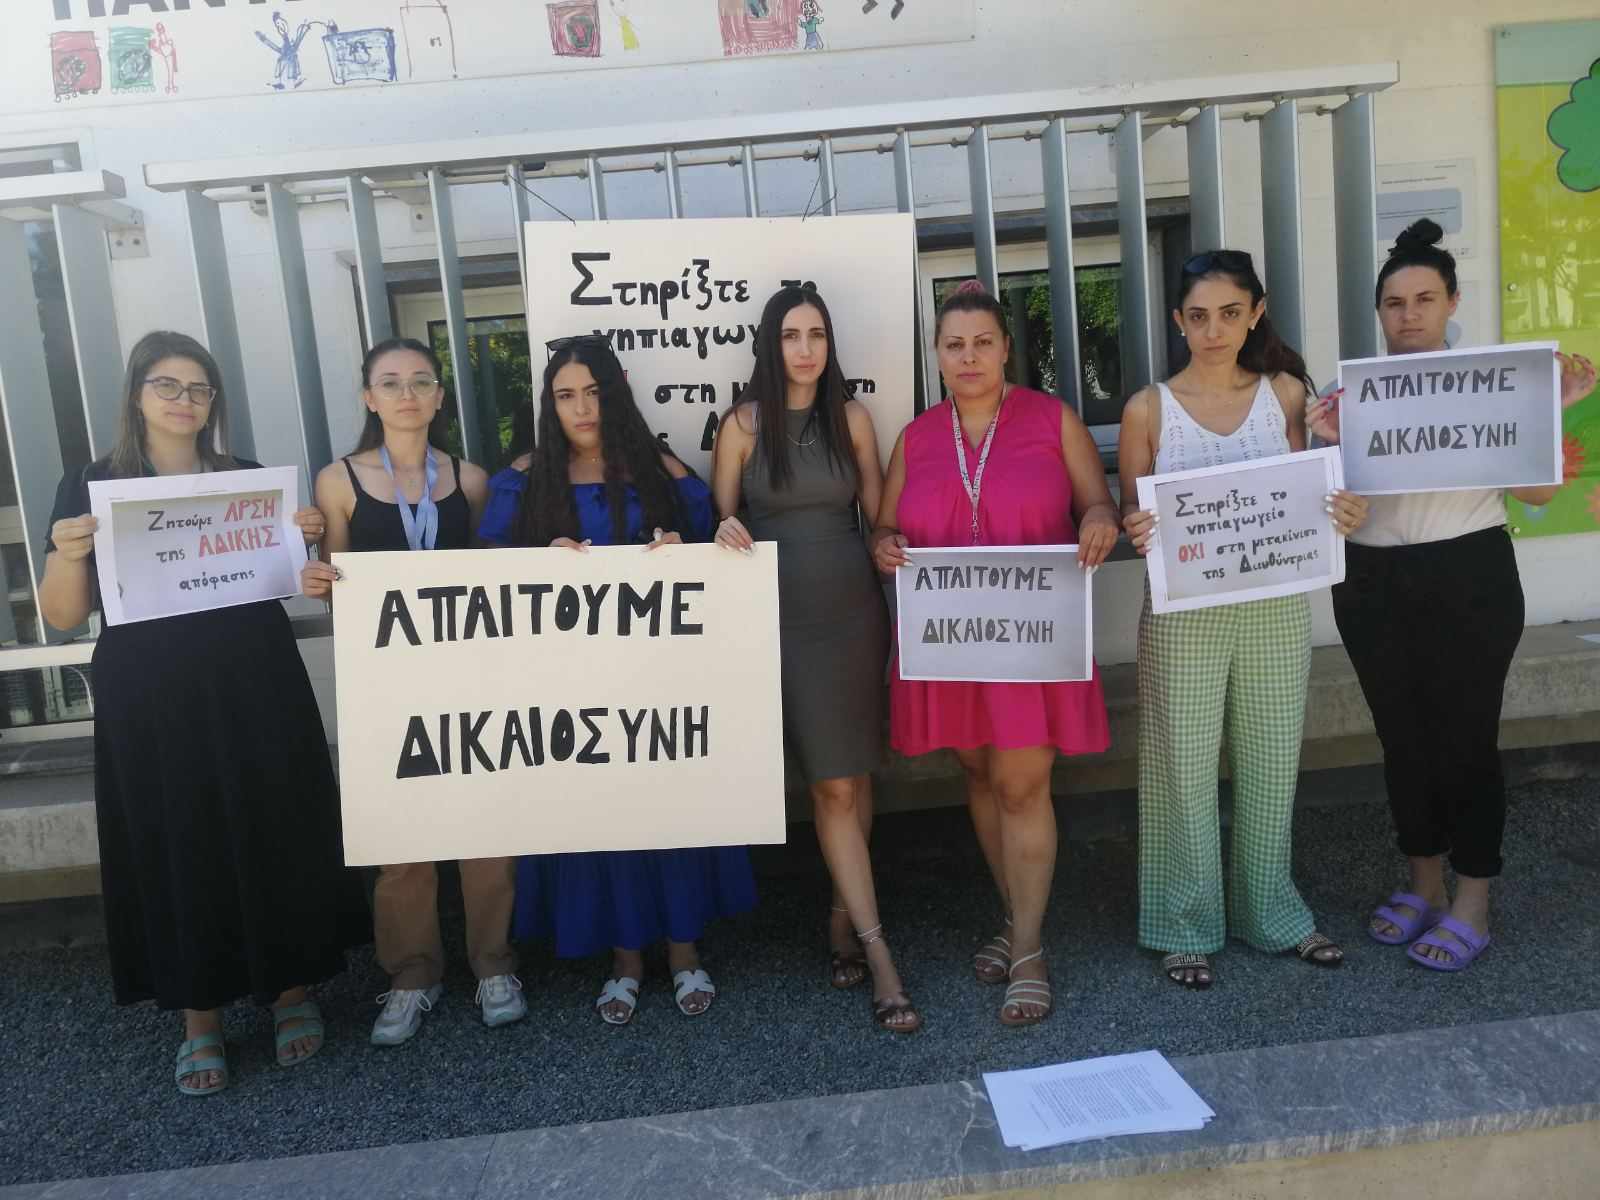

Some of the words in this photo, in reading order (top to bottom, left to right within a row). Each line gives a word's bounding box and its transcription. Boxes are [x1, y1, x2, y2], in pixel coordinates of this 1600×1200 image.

[570, 252, 751, 320] Στηρίξτε
[655, 383, 716, 404] στη
[1359, 367, 1517, 403] ΑΠΑΙΤΟΥΜΕ
[1367, 422, 1517, 457] ΔΙΚΑΙΟΣΥΝΗ
[147, 510, 213, 531] Ζητούμε
[223, 496, 277, 522] ΑΡΣΗ
[1175, 489, 1257, 518] Στηρίξτε
[1270, 491, 1288, 501] το
[1186, 507, 1286, 535] νηπιαγωγείο
[155, 548, 186, 563] της
[198, 524, 281, 558] ΑΔΙΚΗΣ
[1216, 542, 1246, 555] στη
[178, 570, 255, 590] απόφασης
[914, 565, 1054, 591] ΑΠΑΙΤΟΥΜΕ
[1202, 567, 1225, 580] της
[375, 580, 705, 648] ΑΠΑΙΤΟΥΜΕ
[921, 616, 1054, 645] ΔΙΚΑΙΟΣΥΝΗ
[396, 705, 709, 779] ΔΙΚΑΙΟΣΥΝΗ
